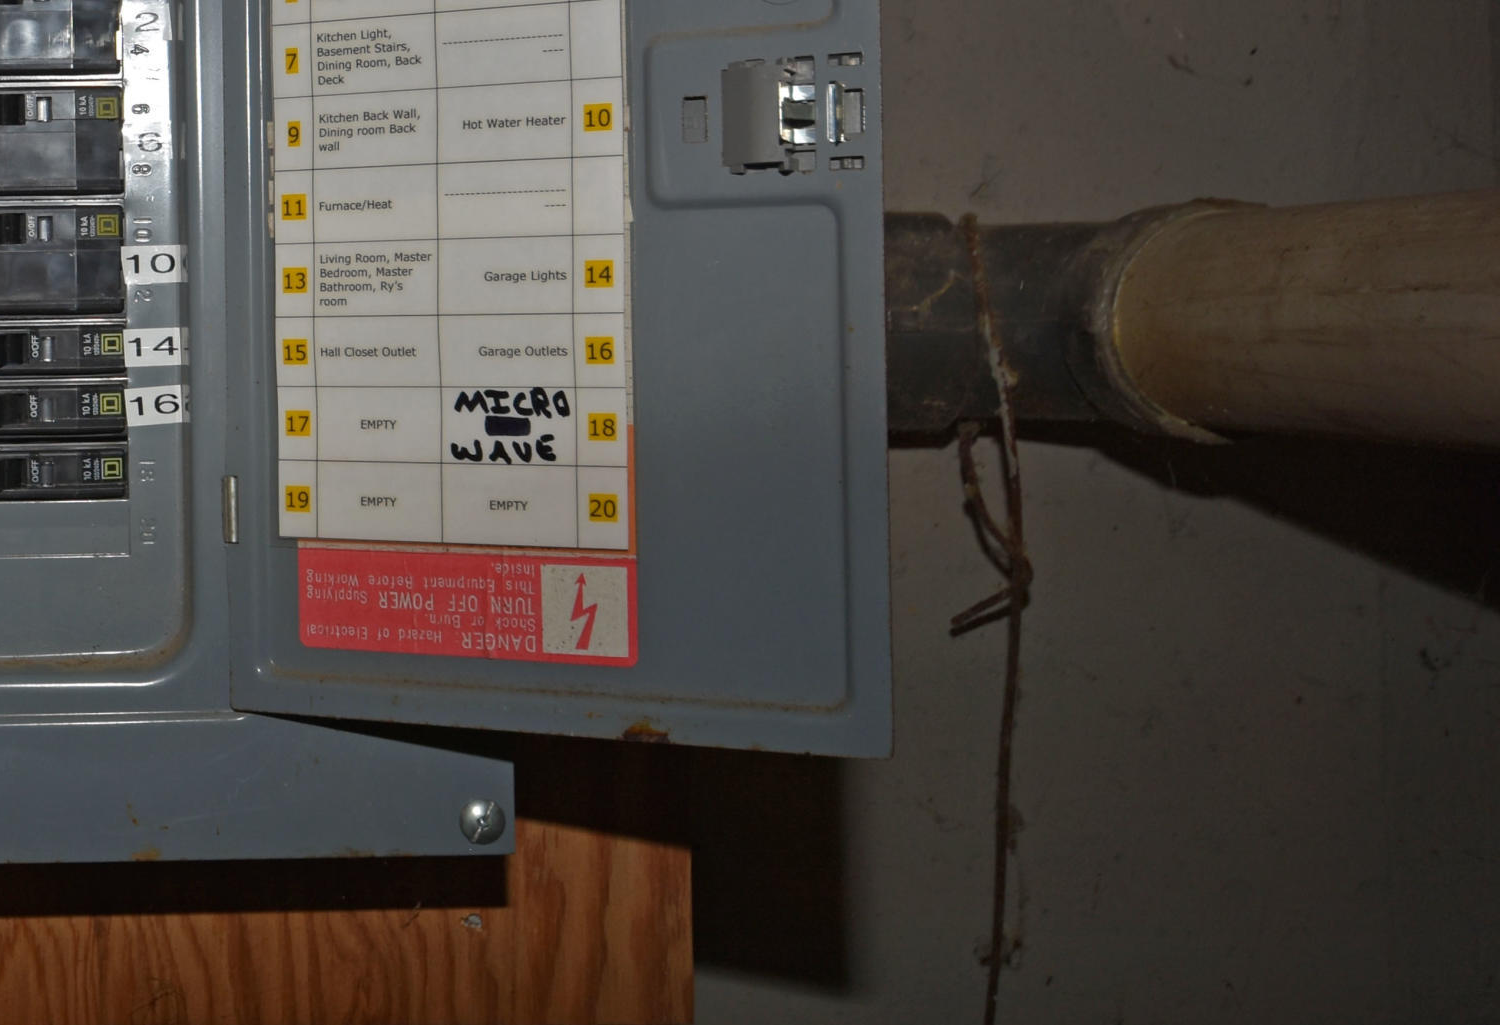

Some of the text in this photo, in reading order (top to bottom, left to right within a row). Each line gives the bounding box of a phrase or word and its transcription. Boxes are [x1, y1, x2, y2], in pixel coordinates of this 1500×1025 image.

[135, 13, 160, 32] 2
[316, 29, 392, 43] Kitchen Light,
[317, 41, 411, 57] Basement Stairs,
[287, 53, 297, 71] 7
[317, 54, 422, 73] Dining Room, Back
[317, 74, 344, 86] Deck
[319, 108, 420, 124] Kitchen Back Wall,
[462, 114, 566, 130] Hot Water Heater
[585, 109, 611, 127] 10
[289, 126, 299, 144] 9
[319, 123, 417, 138] Dining room Back
[319, 140, 340, 152] wall
[283, 200, 305, 217] 11
[319, 199, 393, 212] Furnace/Heat
[126, 254, 175, 274] 10
[320, 251, 432, 266] Living Room, Master
[320, 266, 413, 279] Bedroom, Master
[484, 269, 567, 285] Garage Lights
[587, 265, 611, 283] 14
[284, 273, 306, 290] 13
[320, 281, 377, 294] Bathroom,
[320, 297, 348, 306] room
[128, 336, 177, 357] 14
[284, 344, 307, 361] 15
[320, 346, 417, 357] Hall Closet Outlet
[479, 345, 568, 360] Garage Outlets
[588, 342, 613, 360] 16
[130, 394, 179, 416] 16
[454, 386, 570, 418] MICRO
[287, 416, 308, 432] 17
[360, 419, 396, 430] EMPTY
[590, 419, 615, 436] 18
[451, 435, 557, 465] WAVE
[287, 491, 309, 508] 19
[360, 496, 396, 508] EMPTY
[489, 500, 528, 512] EMPTY
[590, 499, 616, 518] 20
[306, 569, 535, 594] This Equipment Before Working
[306, 585, 535, 613] TURN OFF POWER Supplying
